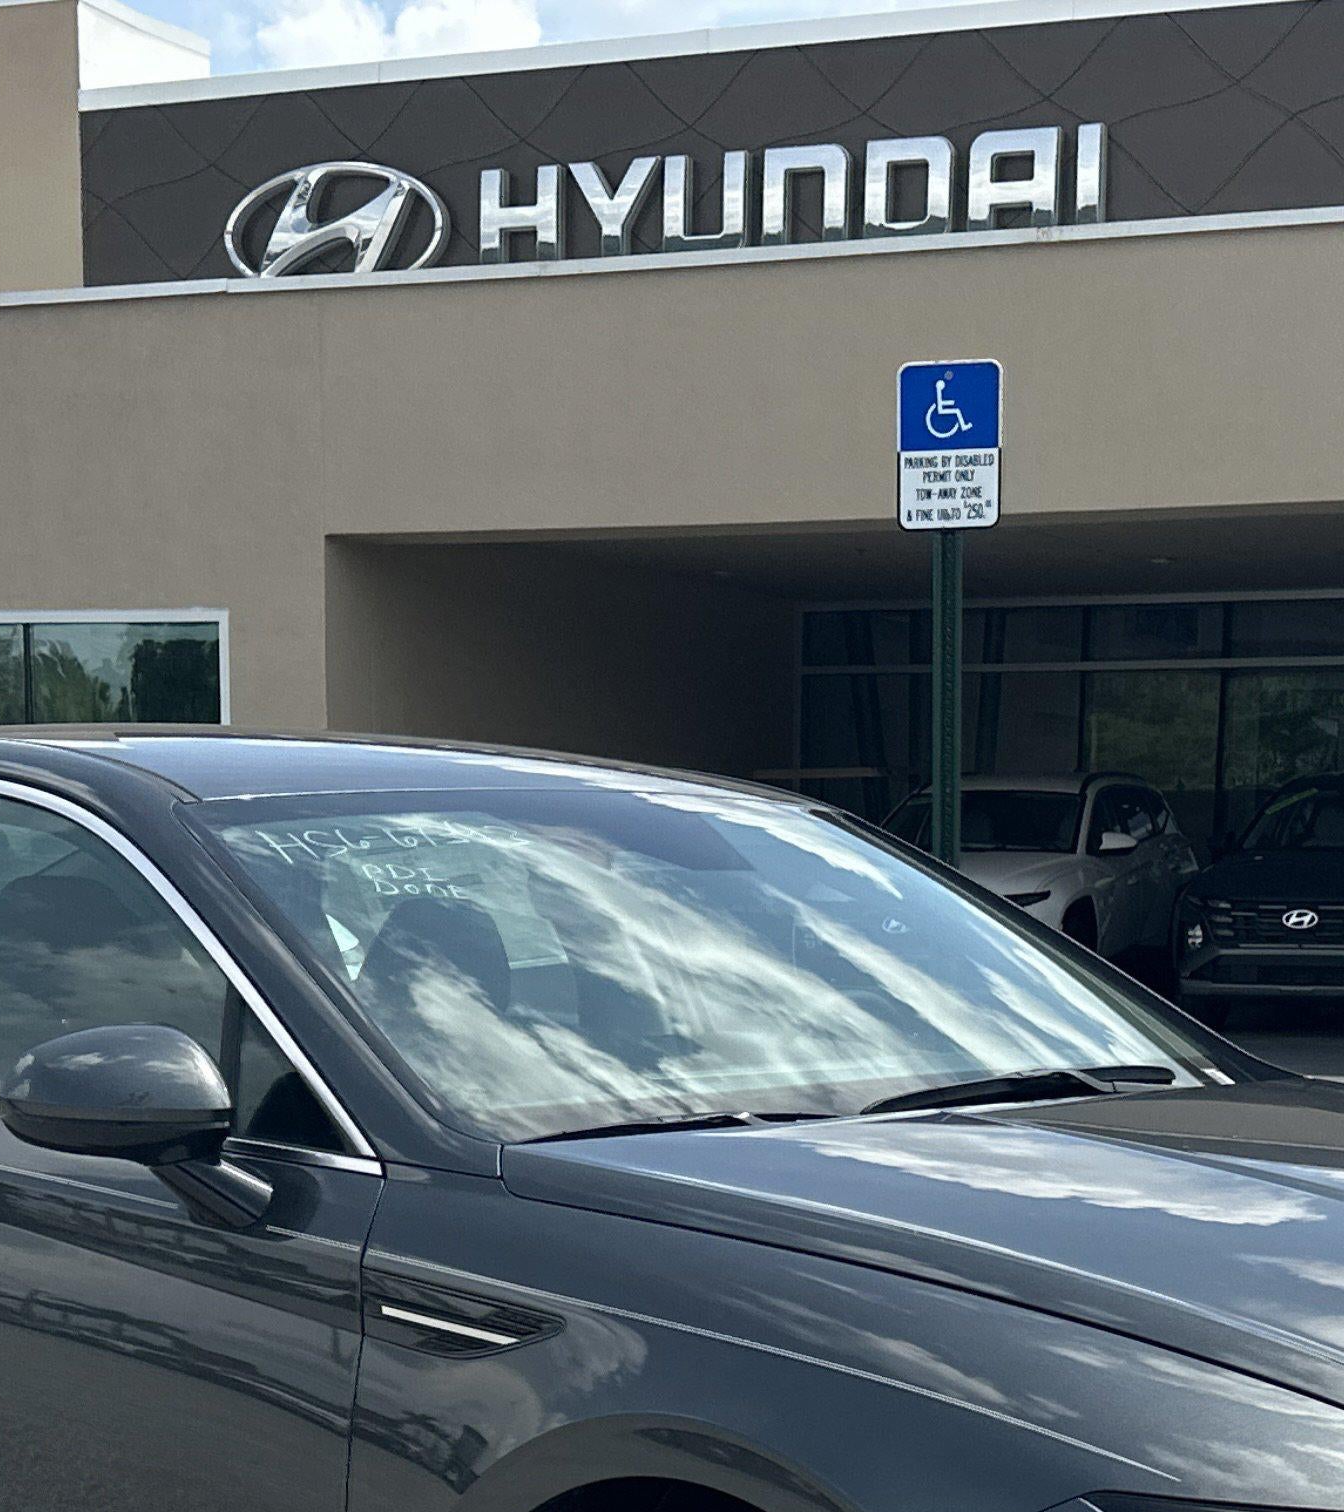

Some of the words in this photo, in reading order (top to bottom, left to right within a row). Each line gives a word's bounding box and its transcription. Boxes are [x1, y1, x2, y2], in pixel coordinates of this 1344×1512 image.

[479, 122, 1108, 264] HYUNDAI
[904, 456, 938, 469] PARKING
[941, 455, 952, 467] BY
[955, 453, 995, 467] DISABLED
[923, 470, 952, 483] PERMIT
[955, 469, 975, 482] ONLY
[916, 487, 957, 501] TOW-AWAY
[960, 486, 983, 499] ZONE
[916, 508, 934, 522] FINE
[361, 863, 449, 882] PDI
